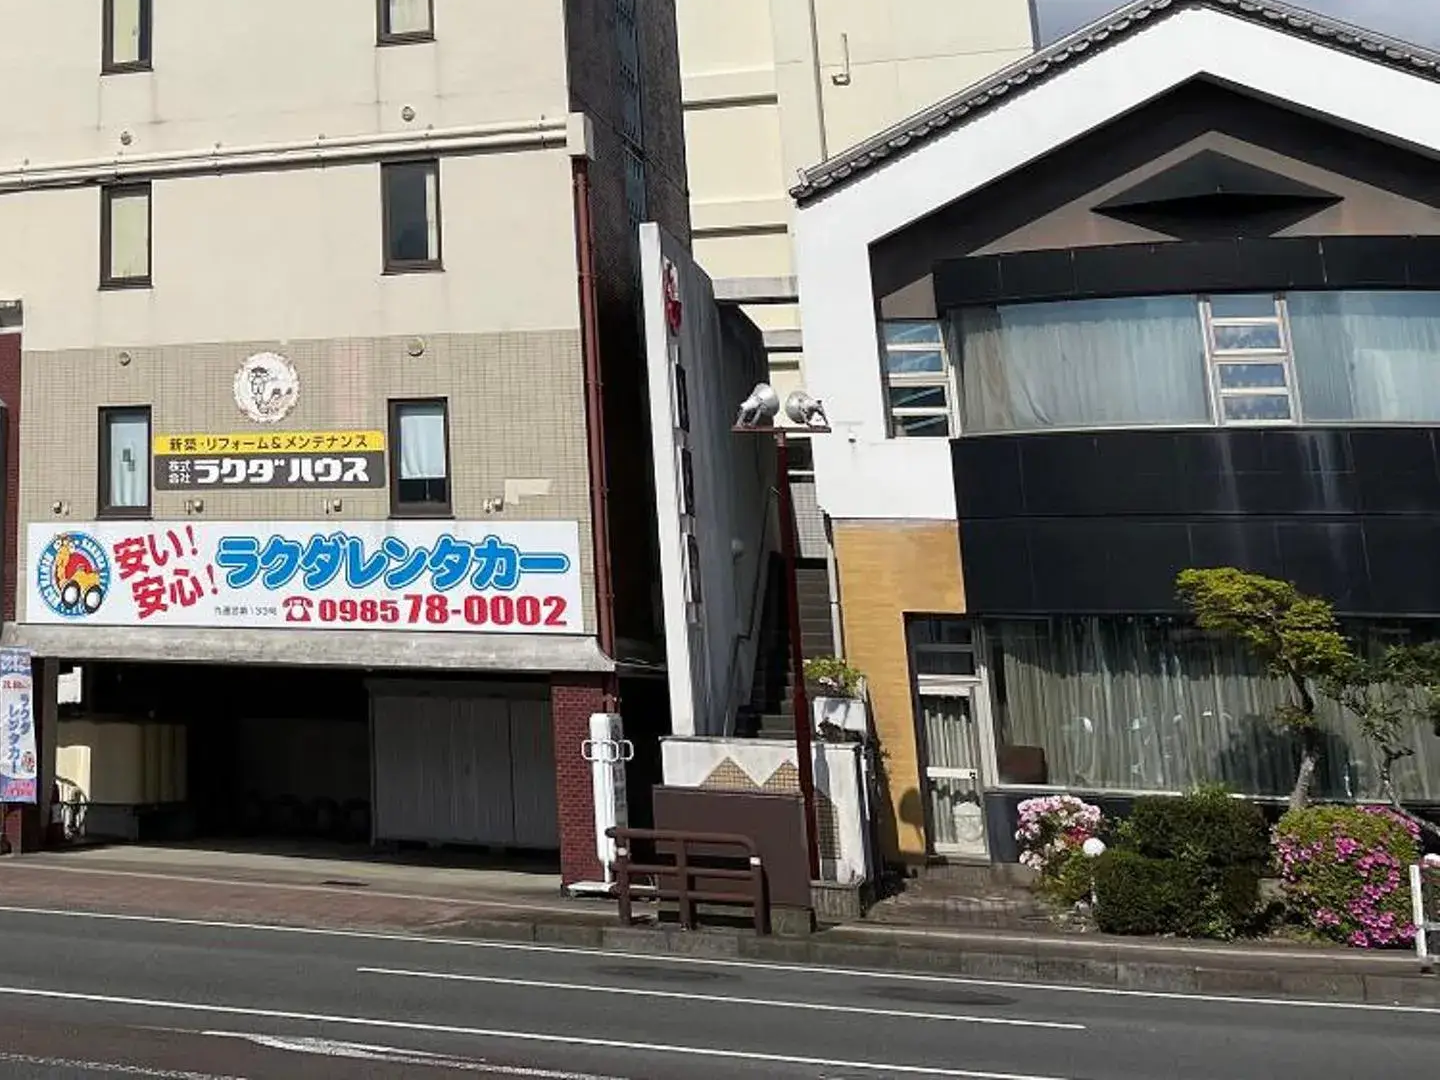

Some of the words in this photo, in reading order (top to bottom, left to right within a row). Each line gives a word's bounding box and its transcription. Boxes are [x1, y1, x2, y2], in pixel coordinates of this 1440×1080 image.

[194, 457, 370, 484] ラクダハウス
[113, 525, 198, 580] 安い!
[215, 532, 571, 591] ラクダレンタカー
[132, 565, 218, 619] 安心!
[318, 599, 400, 622] 0985
[404, 594, 568, 627] 78-0002
